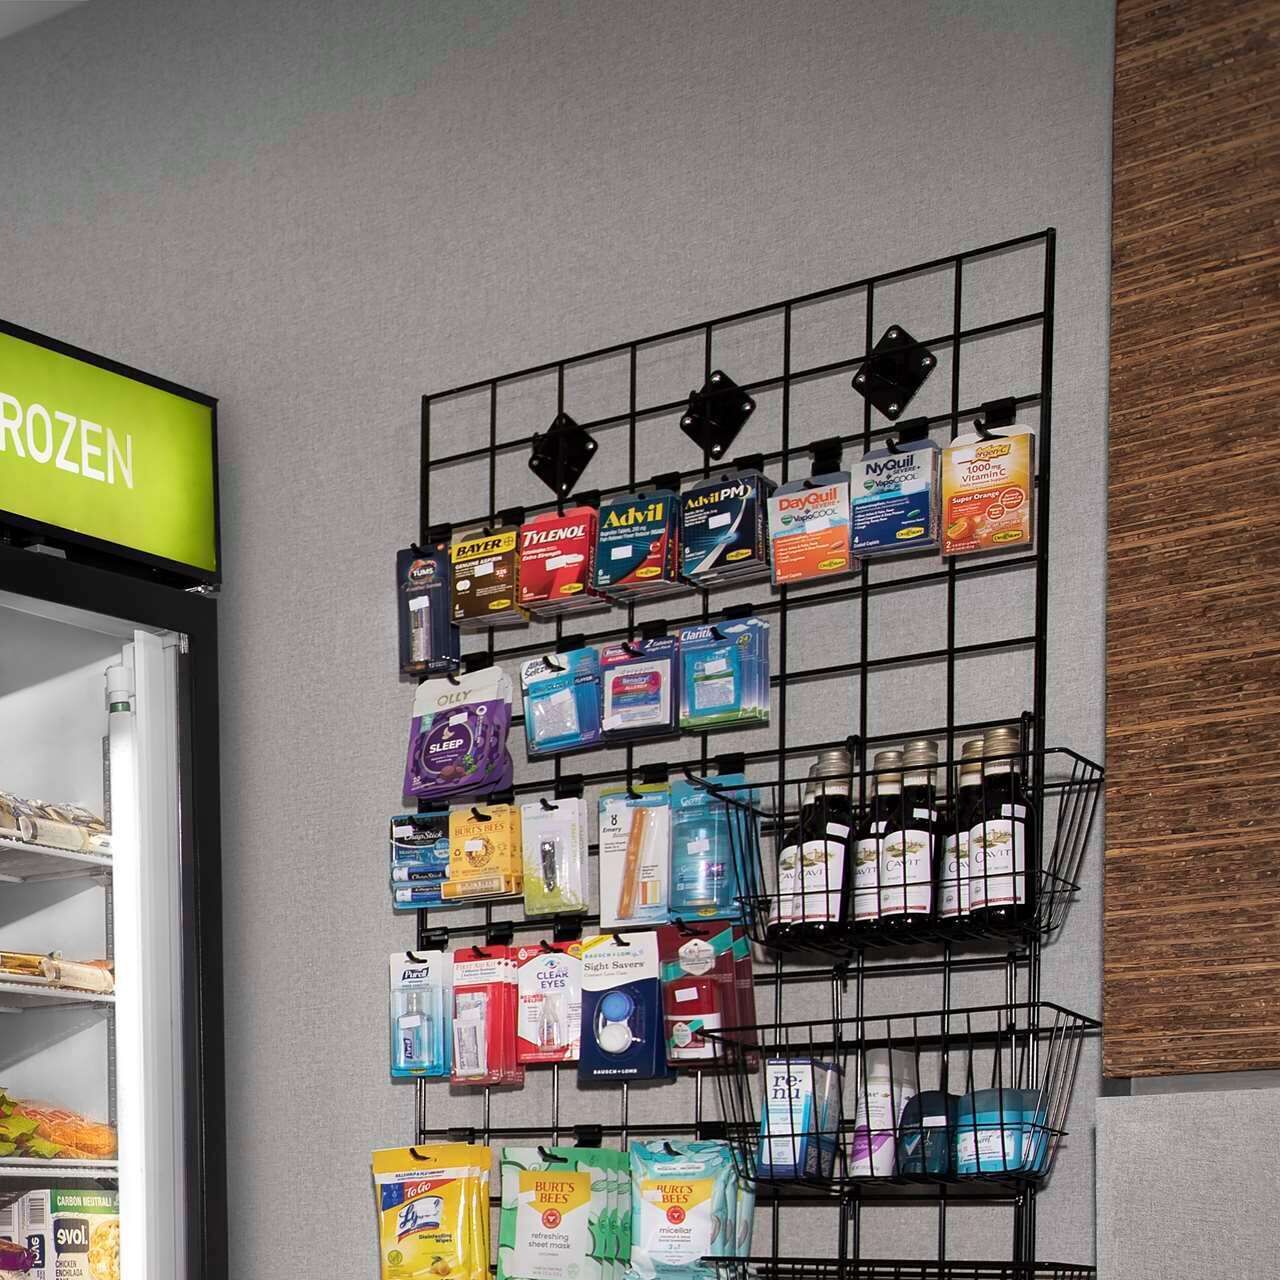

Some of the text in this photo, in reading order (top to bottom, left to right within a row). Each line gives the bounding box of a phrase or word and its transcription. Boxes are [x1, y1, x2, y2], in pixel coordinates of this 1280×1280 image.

[865, 454, 914, 476] NyQuil
[875, 473, 919, 488] VapoCOOL
[961, 471, 997, 483] Vitamin
[684, 485, 744, 510] Advil PM
[778, 487, 838, 512] DayQuil
[952, 490, 1001, 504] Super Orange
[603, 503, 664, 529] Advil
[792, 508, 839, 523] VapoCOOL
[522, 524, 587, 547] TYLENOL
[456, 538, 503, 557] BAYER
[412, 567, 434, 578] TUMS
[437, 689, 472, 706] OLLY
[429, 738, 464, 755] SLEEP
[481, 821, 505, 832] BEES
[602, 826, 623, 834] Emery
[885, 856, 921, 872] CAVIT
[584, 959, 643, 973] Sight Savers
[536, 971, 568, 981] CLEAR
[540, 980, 566, 989] EYES
[535, 1181, 575, 1193] BURT'S
[656, 1184, 696, 1195] BURT'S
[56, 1196, 82, 1207] CARBON
[539, 1192, 569, 1204] BEES
[661, 1193, 689, 1204] BEES
[659, 1226, 692, 1235] micellar
[530, 1232, 569, 1243] refreshing
[528, 1240, 571, 1249] sheet mask
[55, 1260, 77, 1268] CHICKEN
[55, 1269, 83, 1278] ENCHILADA
